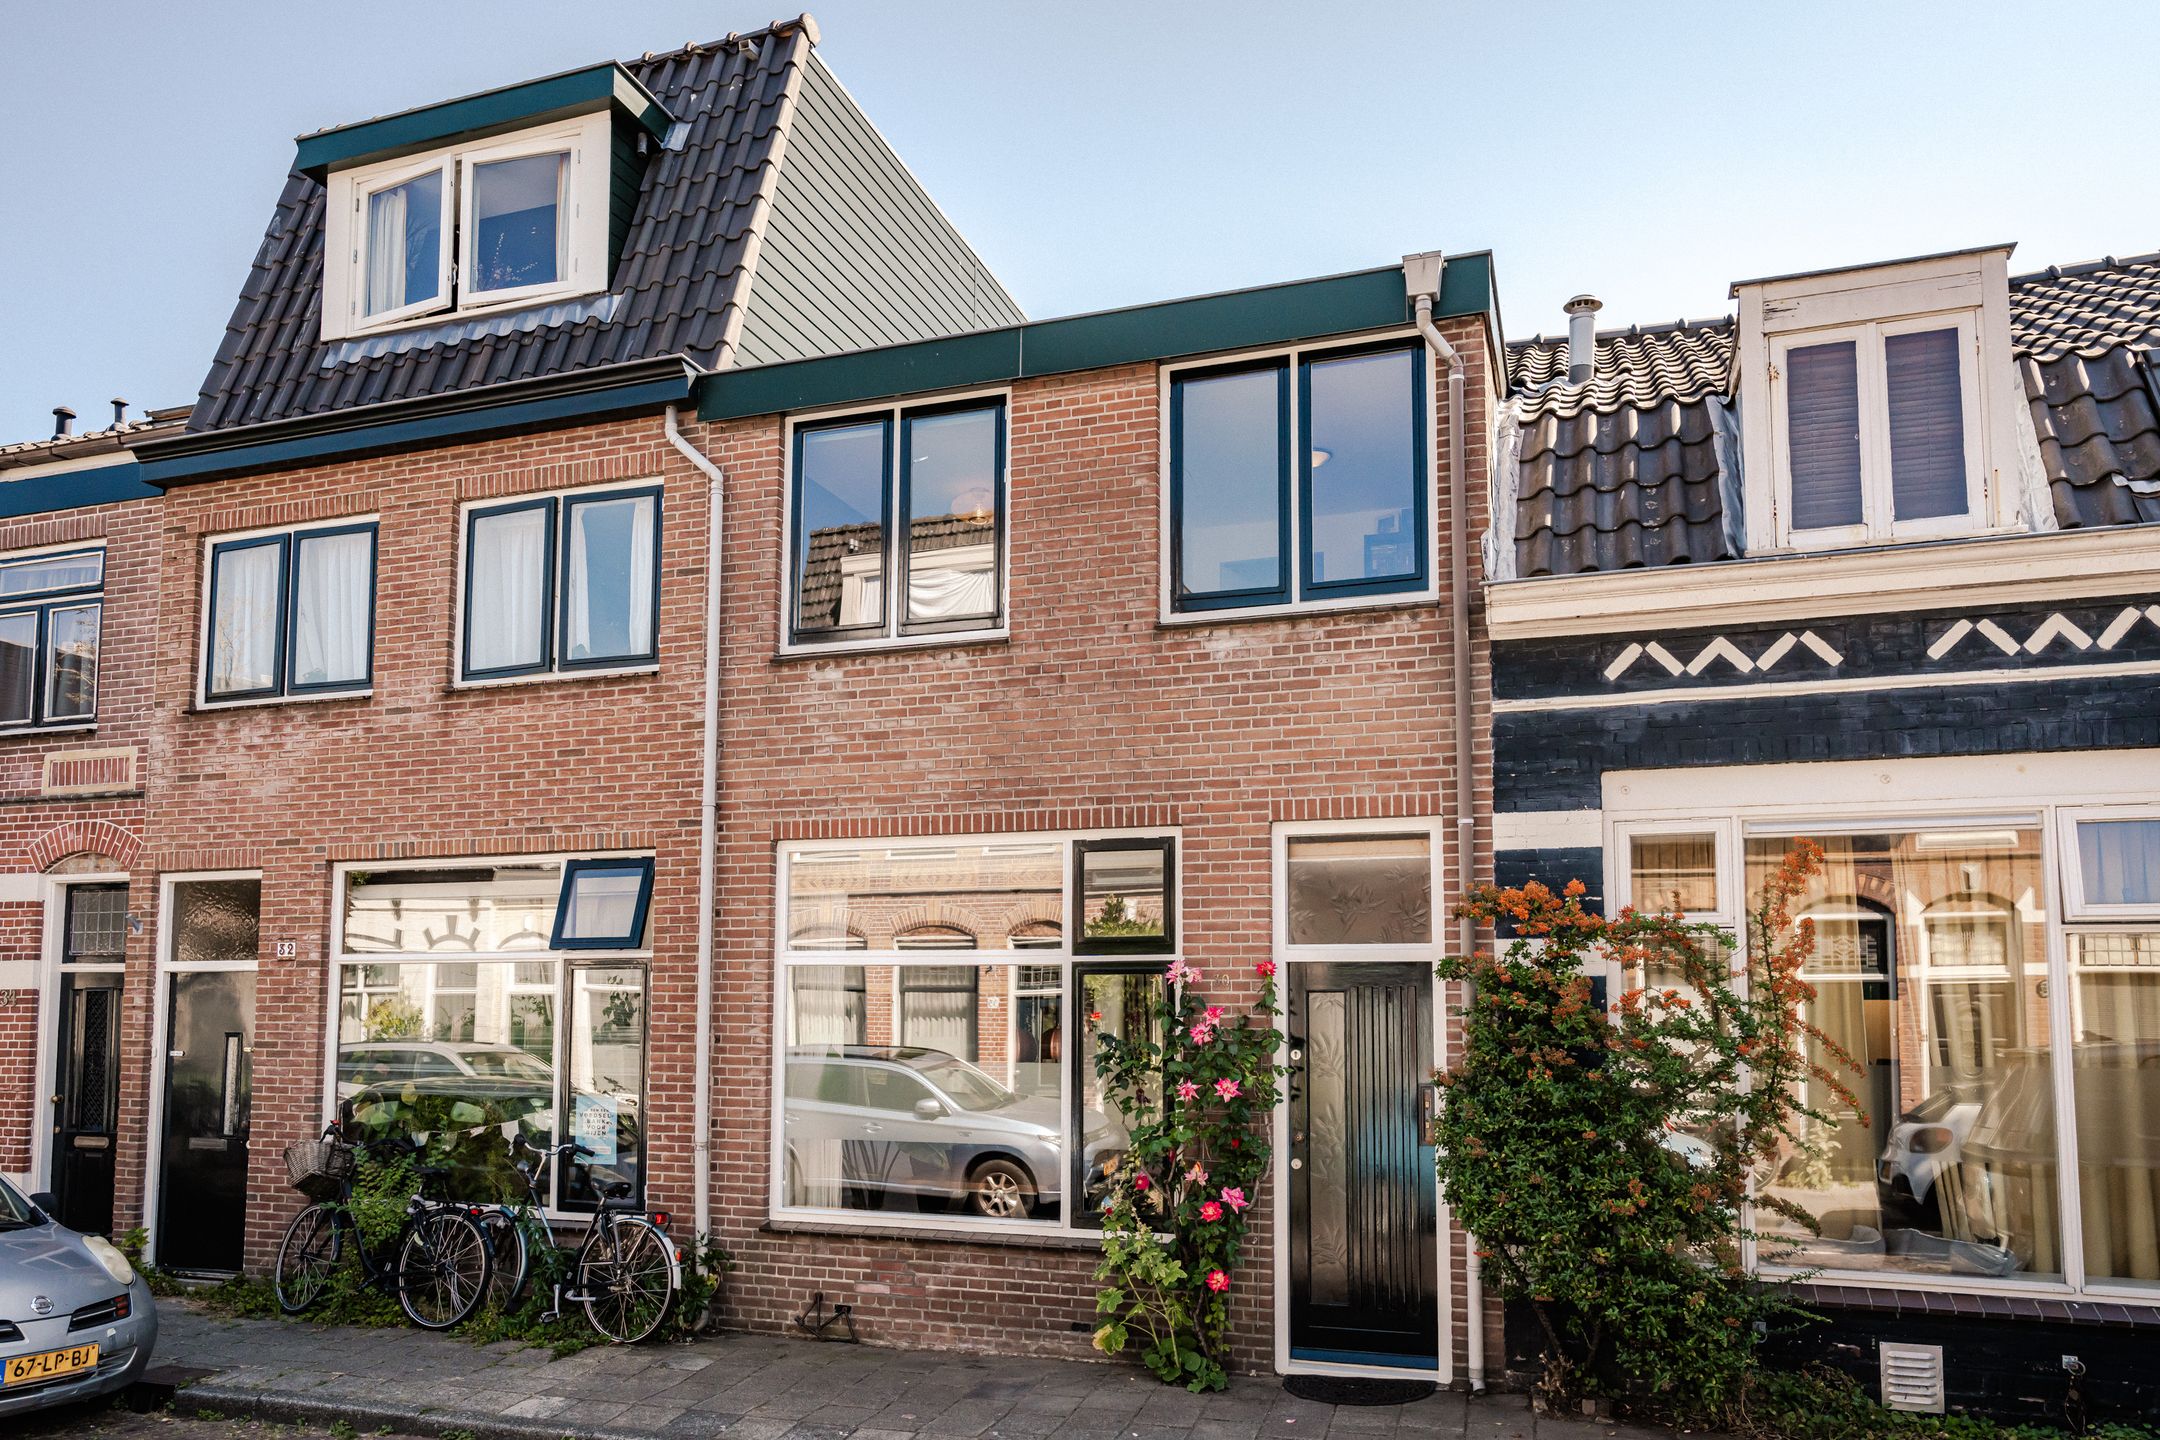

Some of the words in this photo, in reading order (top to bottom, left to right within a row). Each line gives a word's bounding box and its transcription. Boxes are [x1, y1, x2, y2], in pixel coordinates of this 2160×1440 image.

[279, 943, 294, 955] 32
[1, 990, 17, 1006] 34
[14, 1348, 90, 1377] 67-LP-BJ
